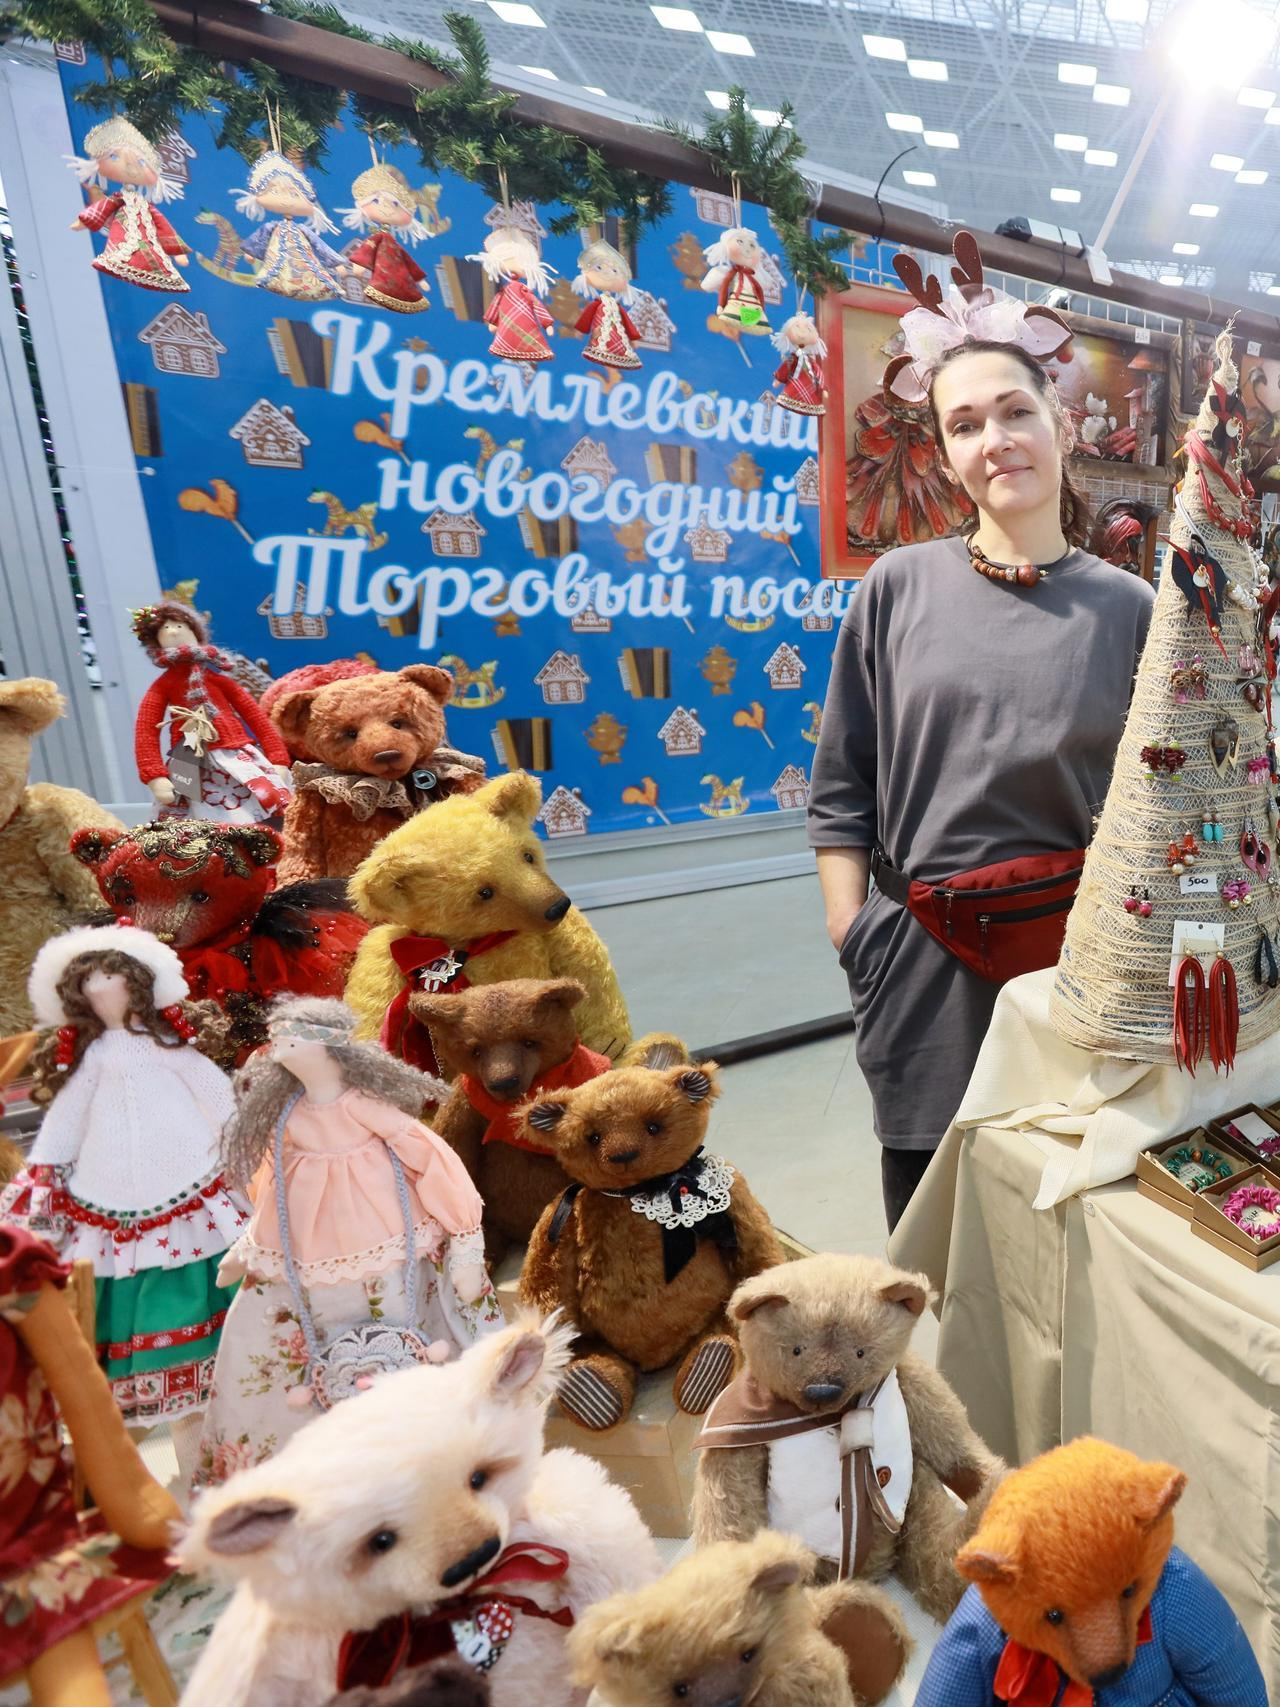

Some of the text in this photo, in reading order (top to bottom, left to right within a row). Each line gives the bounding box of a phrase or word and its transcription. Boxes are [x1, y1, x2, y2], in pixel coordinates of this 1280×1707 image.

[377, 448, 802, 558] новогодний
[252, 534, 861, 651] Торговый поса
[1187, 876, 1209, 887] 500
